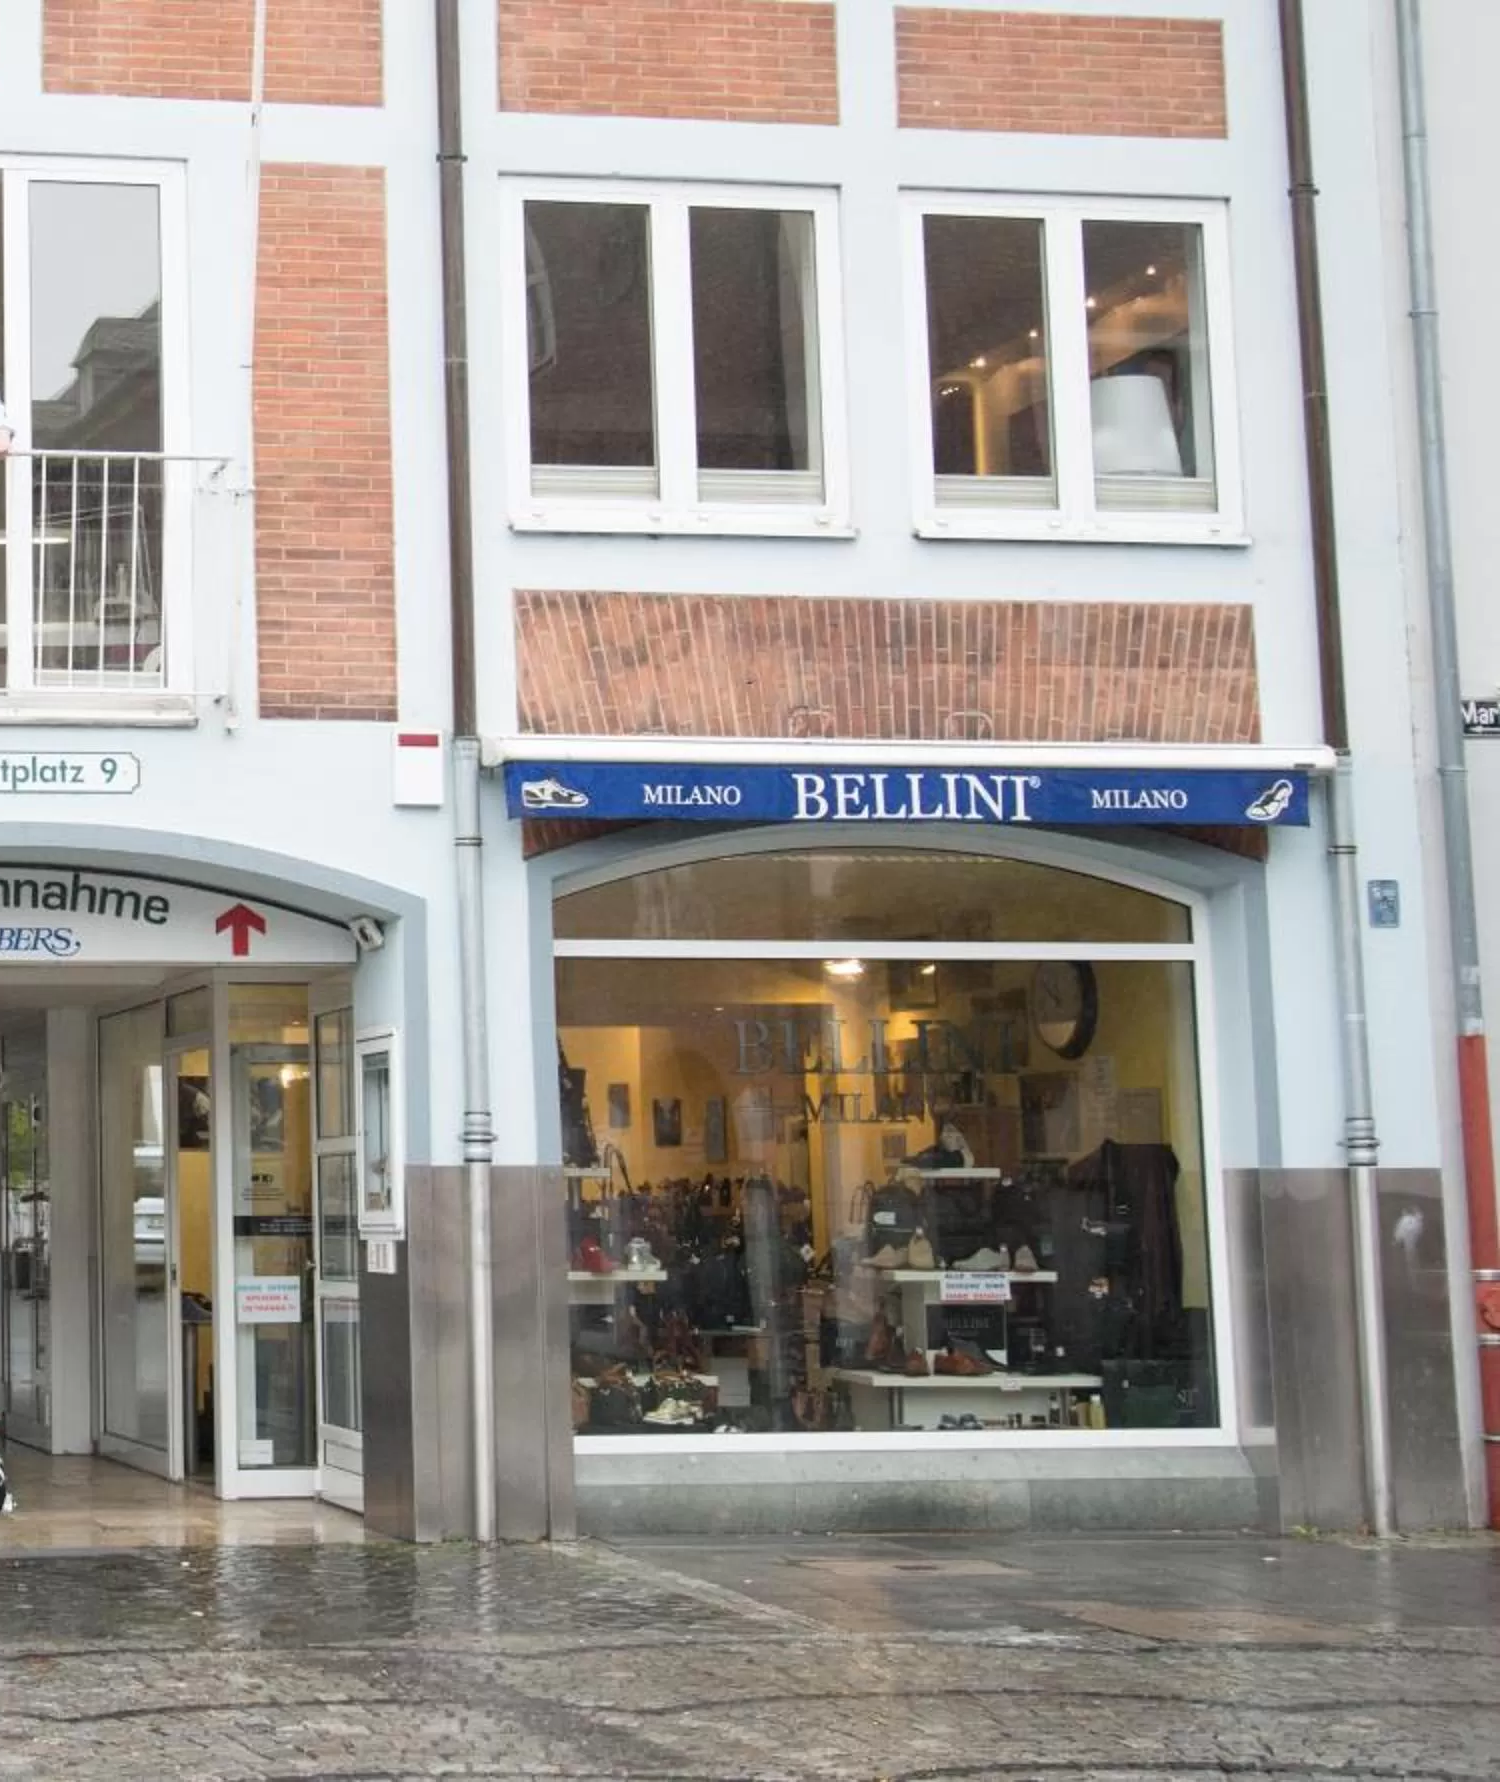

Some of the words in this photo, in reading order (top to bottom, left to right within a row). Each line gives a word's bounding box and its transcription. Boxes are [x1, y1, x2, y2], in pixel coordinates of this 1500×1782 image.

[1461, 700, 1500, 725] Mar
[100, 757, 118, 784] 9
[643, 784, 742, 806] MILANO
[1091, 789, 1189, 809] MILANO
[733, 1018, 1019, 1075] BELLINI
